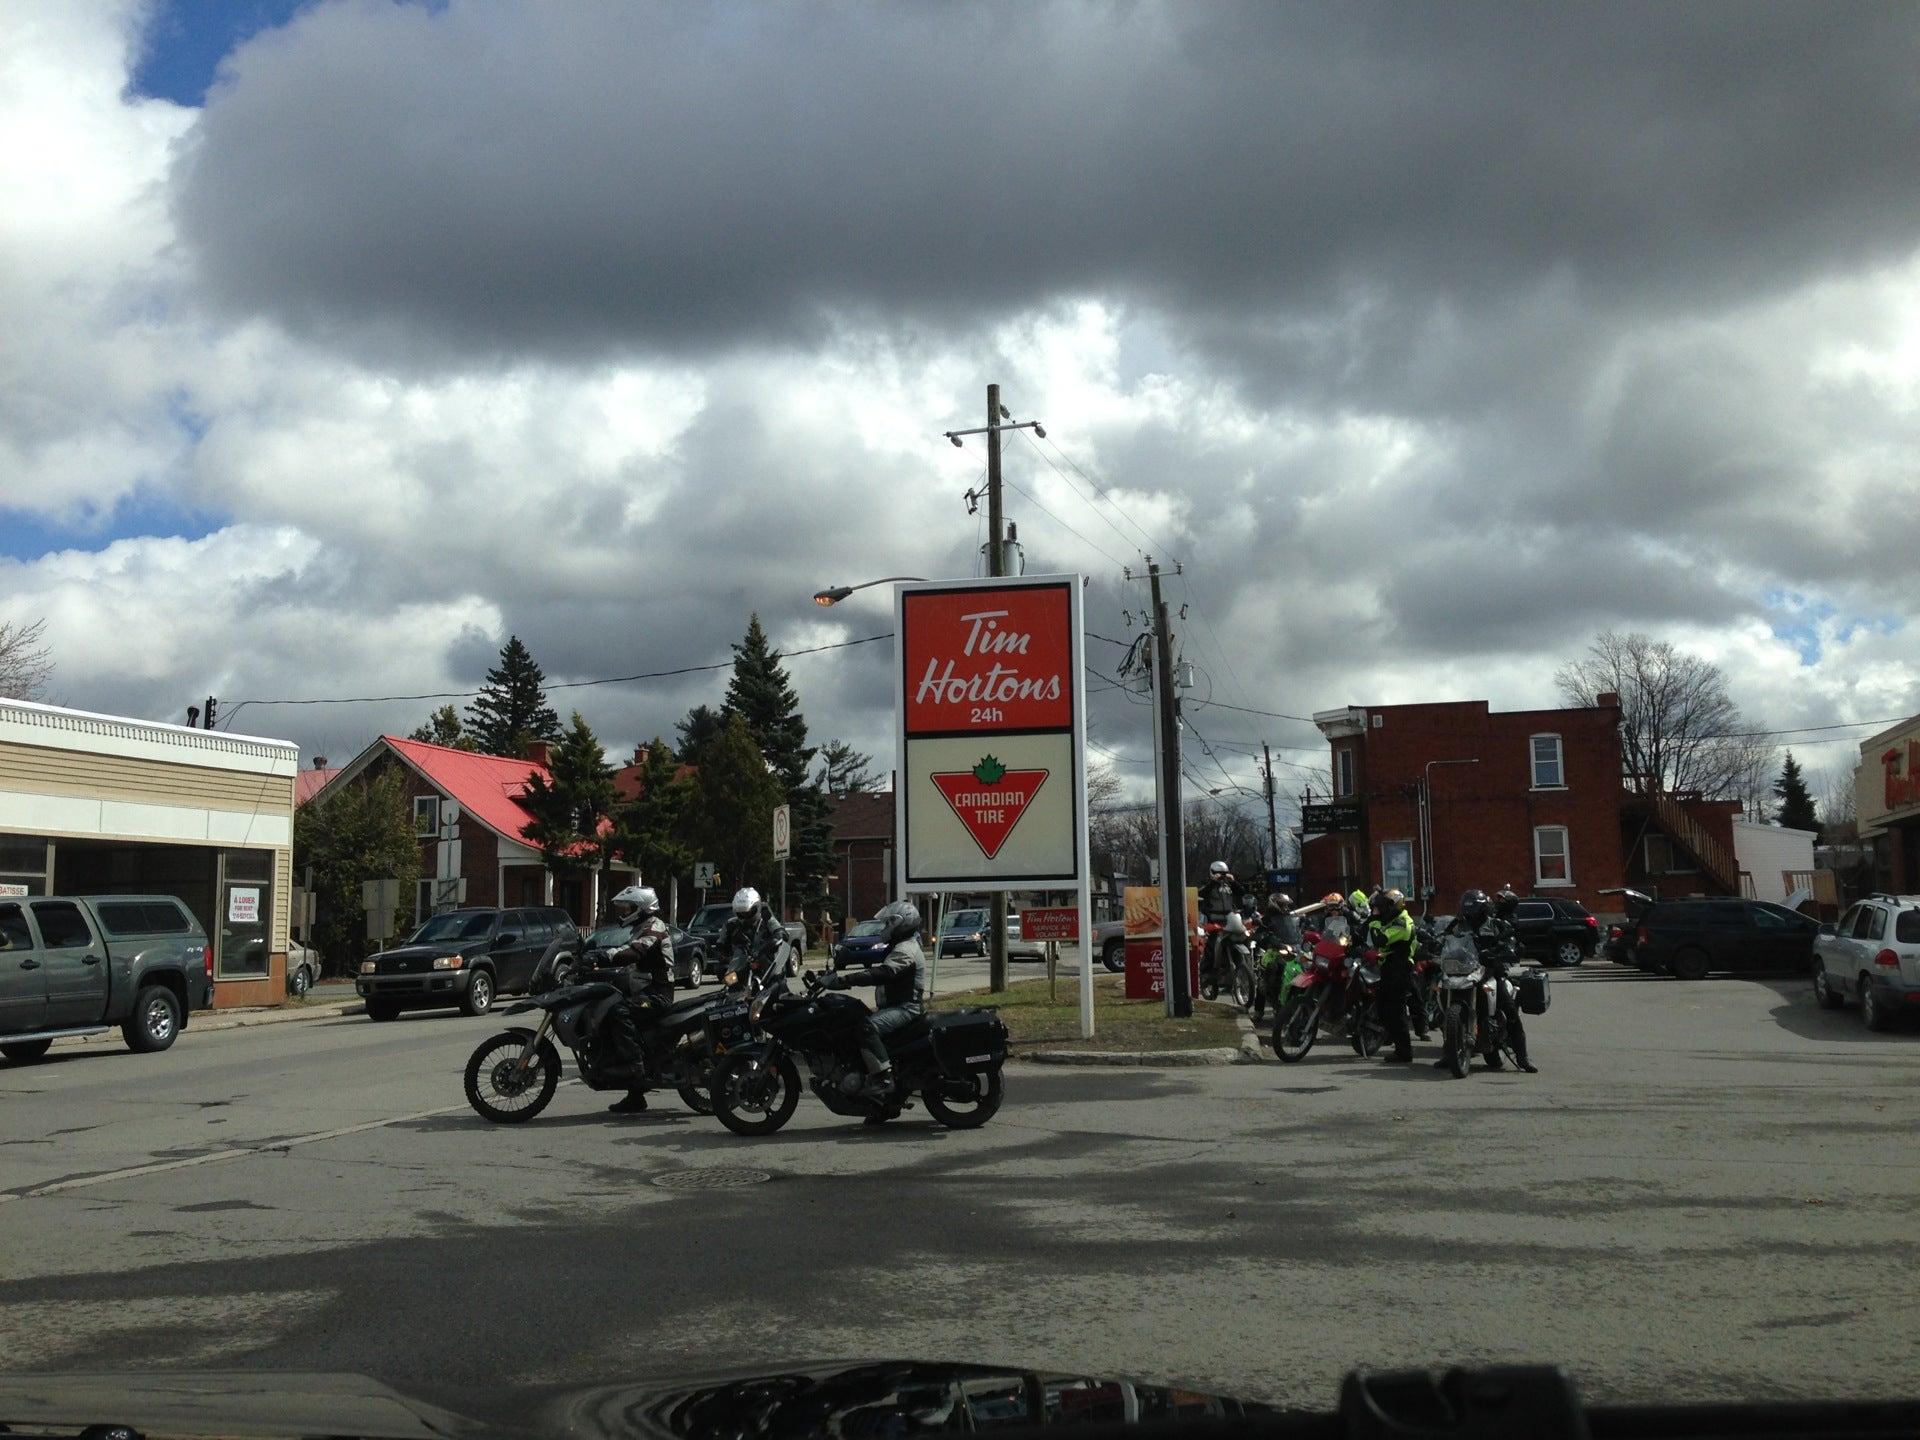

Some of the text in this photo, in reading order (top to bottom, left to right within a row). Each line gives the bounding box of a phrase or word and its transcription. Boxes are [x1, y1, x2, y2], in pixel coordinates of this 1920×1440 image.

[960, 610, 1031, 656] Tim
[916, 657, 1060, 704] Hortons
[971, 708, 1003, 723] 24h
[955, 791, 1024, 807] CANADIAN
[975, 809, 1005, 824] TIRE
[1027, 911, 1042, 923] Tim
